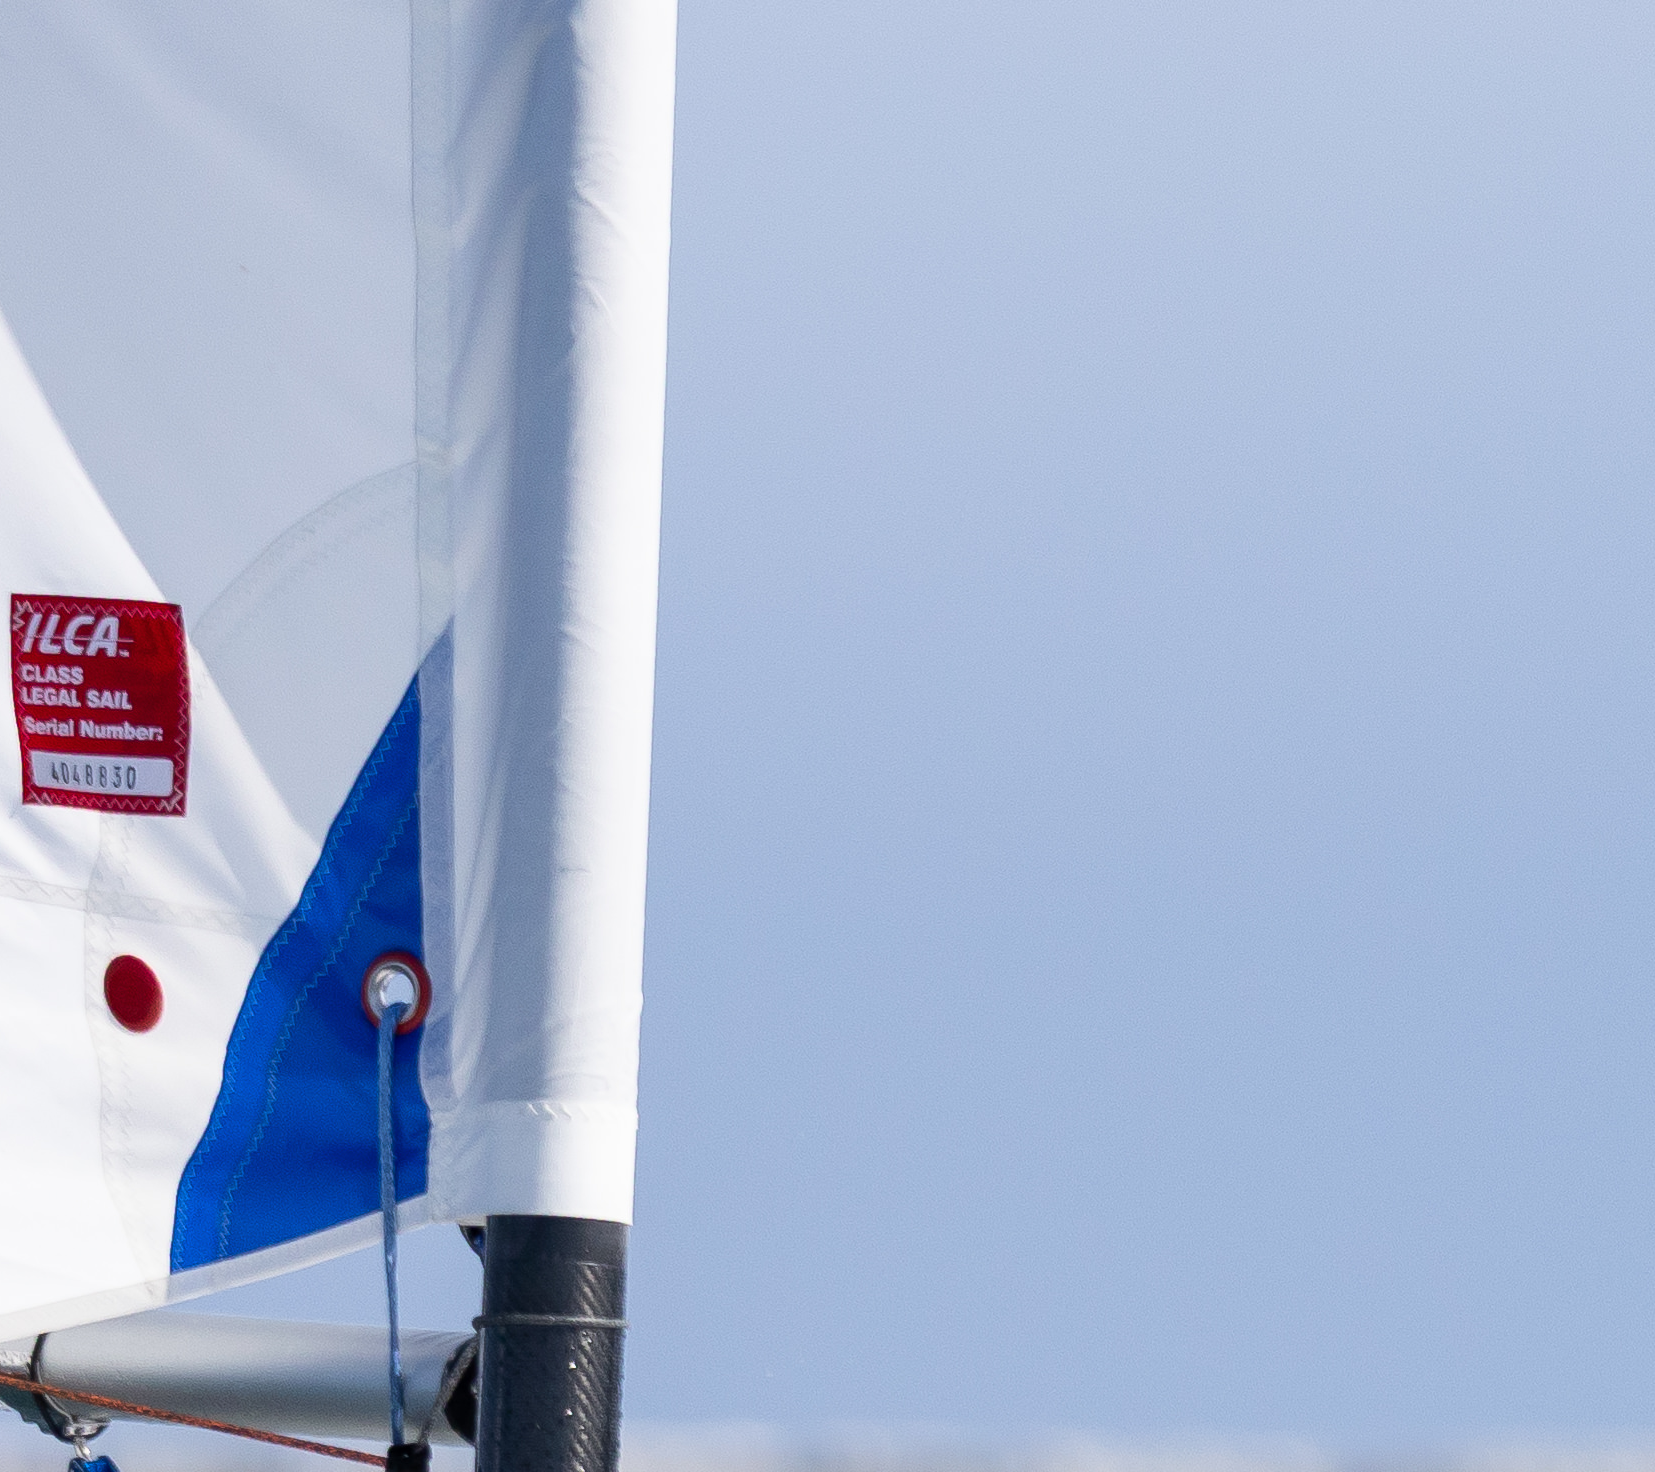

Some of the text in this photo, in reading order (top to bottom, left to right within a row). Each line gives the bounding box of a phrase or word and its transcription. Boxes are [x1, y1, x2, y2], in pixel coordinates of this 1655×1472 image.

[21, 612, 121, 658] ILCA
[21, 664, 84, 686] CLASS
[21, 686, 133, 710] LEGAL SAIL
[22, 716, 164, 742] Serial Number:
